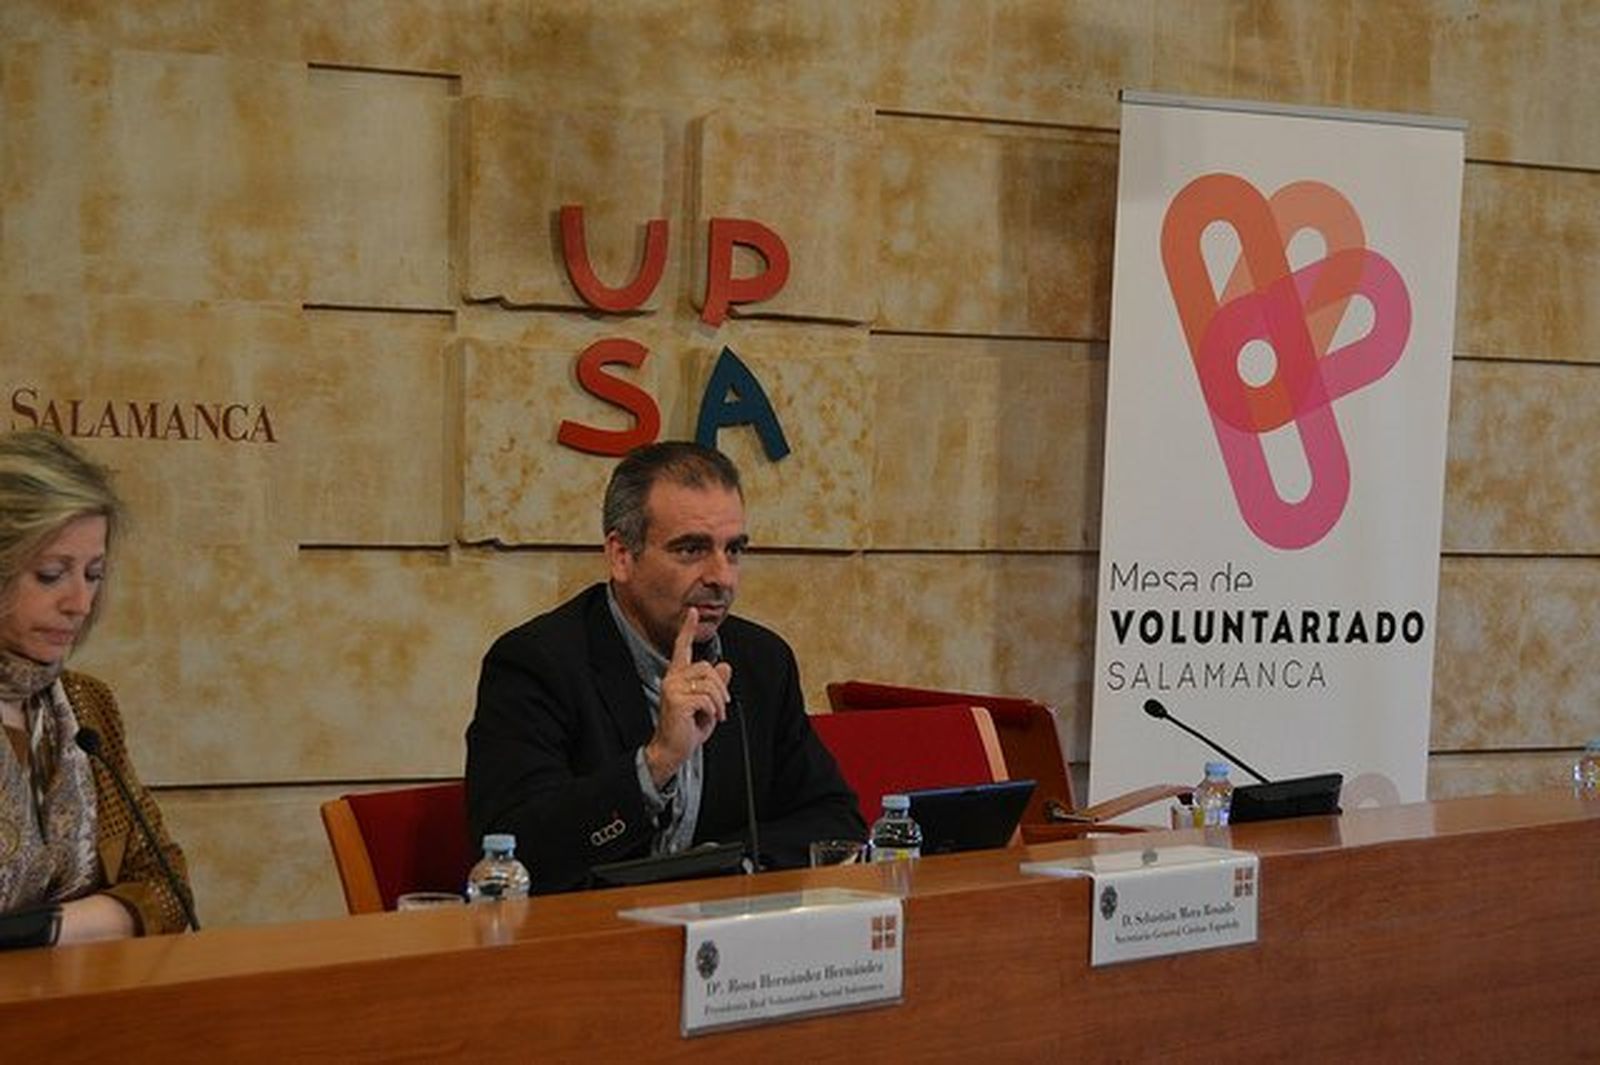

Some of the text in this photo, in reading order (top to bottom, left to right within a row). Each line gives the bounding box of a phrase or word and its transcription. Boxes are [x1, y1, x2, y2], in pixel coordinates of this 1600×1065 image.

[1110, 562, 1253, 592] Mesa de
[1111, 610, 1424, 644] VOLUNTARIADO
[1107, 660, 1326, 690] SALAMANCA
